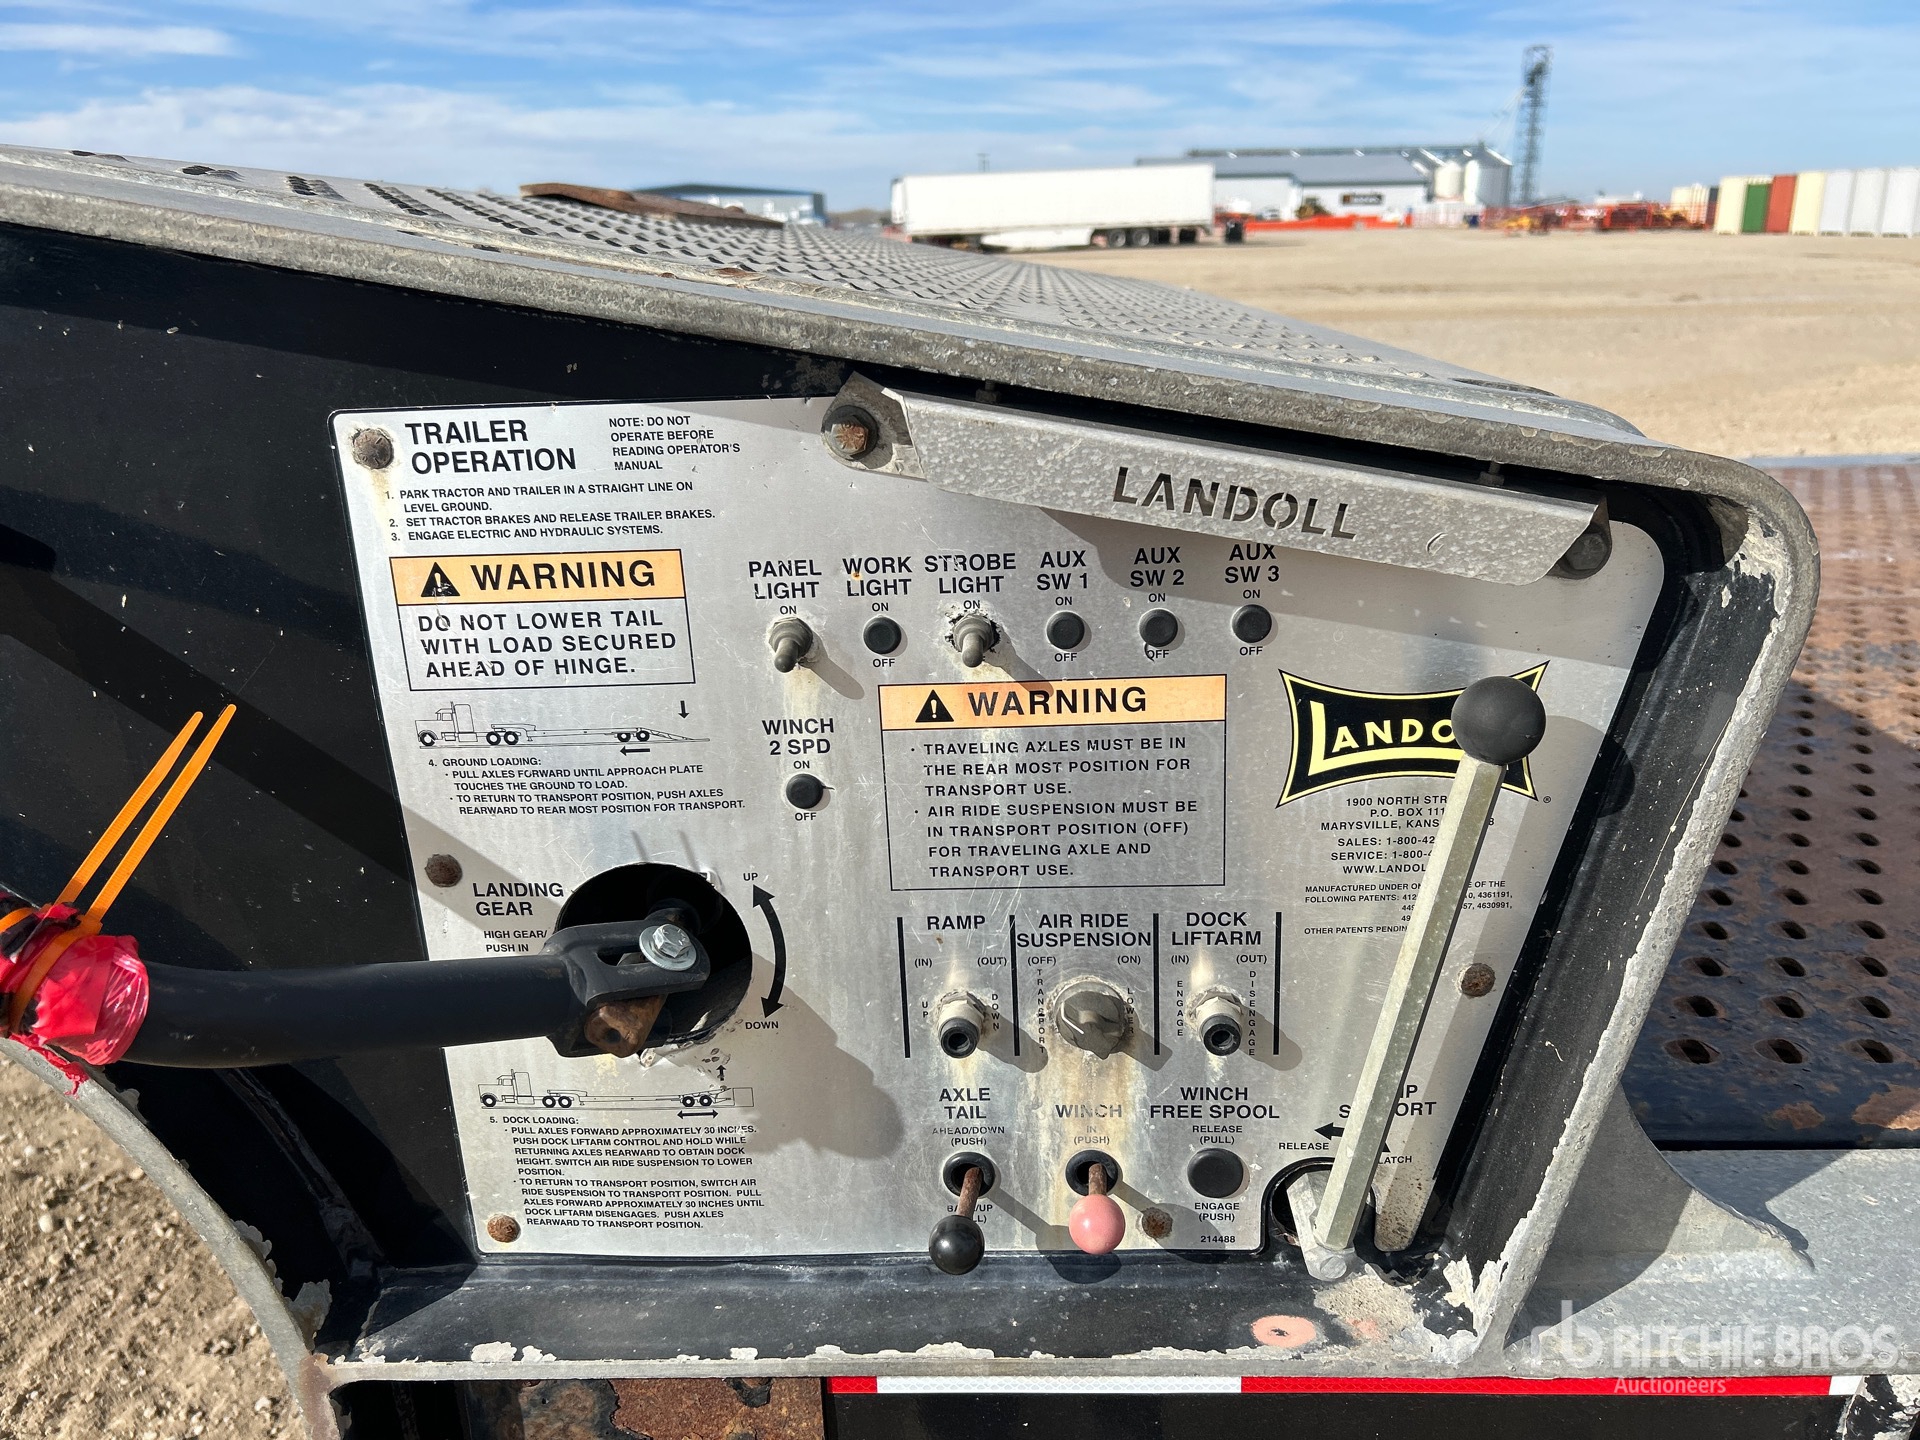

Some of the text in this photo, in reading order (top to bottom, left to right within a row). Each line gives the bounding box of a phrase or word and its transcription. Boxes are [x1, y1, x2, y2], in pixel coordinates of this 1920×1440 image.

[609, 416, 690, 428] NOTE: DO NOT
[406, 420, 528, 445] TRAILER
[611, 429, 714, 442] OPERATE BEFORE
[613, 443, 740, 456] READING OPERATOR'S
[412, 448, 576, 474] OPERATION
[615, 461, 662, 471] MANUAL
[386, 482, 692, 499] 1. PARK TRACTOR AND TRAILER IN A STRAIGHT LINE ON
[405, 502, 492, 513] LEVEL GROUND.
[1113, 467, 1356, 539] LANDOLL
[1134, 547, 1180, 565] AUX
[1229, 543, 1275, 561] AUX
[843, 556, 912, 575] WORK
[924, 553, 1016, 573] STROBE
[1041, 551, 1086, 568] AUX
[749, 560, 822, 577] PANEL
[1225, 565, 1279, 584] SW 3
[471, 560, 655, 591] WARNING
[1037, 572, 1088, 591] SW 1
[1130, 569, 1184, 588] SW 2
[754, 582, 819, 599] LIGHT
[847, 579, 912, 596] LIGHT
[939, 576, 1004, 594] LIGHT
[1148, 593, 1165, 602] ON
[1243, 589, 1260, 599] ON
[964, 600, 980, 609] ON
[1055, 596, 1072, 605] ON
[780, 606, 796, 614] ON
[872, 602, 888, 612] ON
[419, 610, 662, 632] DO NOT LOWER TAIL
[421, 633, 676, 655] WITH LOAD SECURED
[1146, 649, 1169, 659] OFF
[1240, 646, 1263, 655] OFF
[873, 659, 895, 667] OFF
[1054, 653, 1077, 662] OFF
[426, 658, 635, 678] AHEAD OF HINGE.
[968, 687, 1147, 716] WARNING
[762, 718, 834, 735] WINCH
[1308, 701, 1465, 776] LANDO
[770, 739, 830, 755] 2 SPD
[924, 737, 1186, 754] TRAVELING AXLES MUST BE IN
[429, 757, 541, 767] 4. GROUND LOADING:
[794, 761, 810, 769] ON
[1346, 796, 1447, 806] 1900 NORTH STR
[795, 812, 816, 821] OFF
[1370, 809, 1392, 817] P.O.
[1398, 808, 1422, 816] BOX
[1321, 819, 1439, 831] MARYSVILLE, KANS
[1338, 836, 1435, 846] SALES: 1-800-42
[1331, 852, 1388, 860] SERVICE:
[1343, 864, 1426, 874] WWW.LANDOL
[743, 872, 758, 881] UP
[473, 882, 564, 897] LANDING
[1306, 884, 1376, 892] MANUFACTURED
[1488, 880, 1505, 888] THE
[1305, 895, 1356, 903] FOLLOWING
[1359, 894, 1399, 902] PATENTS:
[1478, 891, 1512, 899] 4361191,
[476, 902, 533, 916] GEAR
[1477, 902, 1512, 910] 4630991,
[927, 916, 986, 930] RAMP
[1039, 914, 1128, 929] AIR RIDE
[1186, 912, 1247, 927] DOCK
[484, 929, 547, 939] HIGH GEAR/
[1304, 925, 1408, 935] OTHER PATENTS PENDIN
[1017, 932, 1151, 948] SUSPENSION
[1172, 931, 1261, 946] LIFTARM
[486, 944, 528, 952] PUSH IN
[915, 956, 1007, 968] (IN) (OUT)
[1028, 955, 1141, 966] (OFF) (ON)
[1171, 954, 1267, 965] (IN) (OUT)
[922, 1002, 928, 1018] UP
[992, 994, 1000, 1029] DOWN
[1248, 971, 1256, 1056] DISENGAGE
[745, 1021, 778, 1029] DOWN
[939, 1088, 990, 1102] AXLE
[1180, 1087, 1248, 1101] WINCH
[944, 1106, 986, 1120] TAIL
[1056, 1104, 1122, 1118] WINCH
[1150, 1104, 1279, 1119] FREE SPOOL
[1339, 1102, 1436, 1118] SORT
[932, 1126, 1005, 1135] AHEAD/DOWN
[1086, 1125, 1097, 1133] IN
[1192, 1125, 1242, 1133] RELEASE
[951, 1136, 987, 1147] (PUSH)
[1074, 1135, 1110, 1145] (PUSH)
[1200, 1134, 1234, 1144] (PULL)
[1279, 1142, 1329, 1150] RELEASE
[518, 1168, 564, 1176] POSITION.
[1194, 1202, 1239, 1211] ENGAGE
[1199, 1212, 1235, 1222] (PUSH)
[527, 1218, 580, 1226] REARWARD
[597, 1220, 654, 1228] TRANSPORT
[657, 1221, 703, 1229] POSITION.
[1200, 1235, 1235, 1243] 214488
